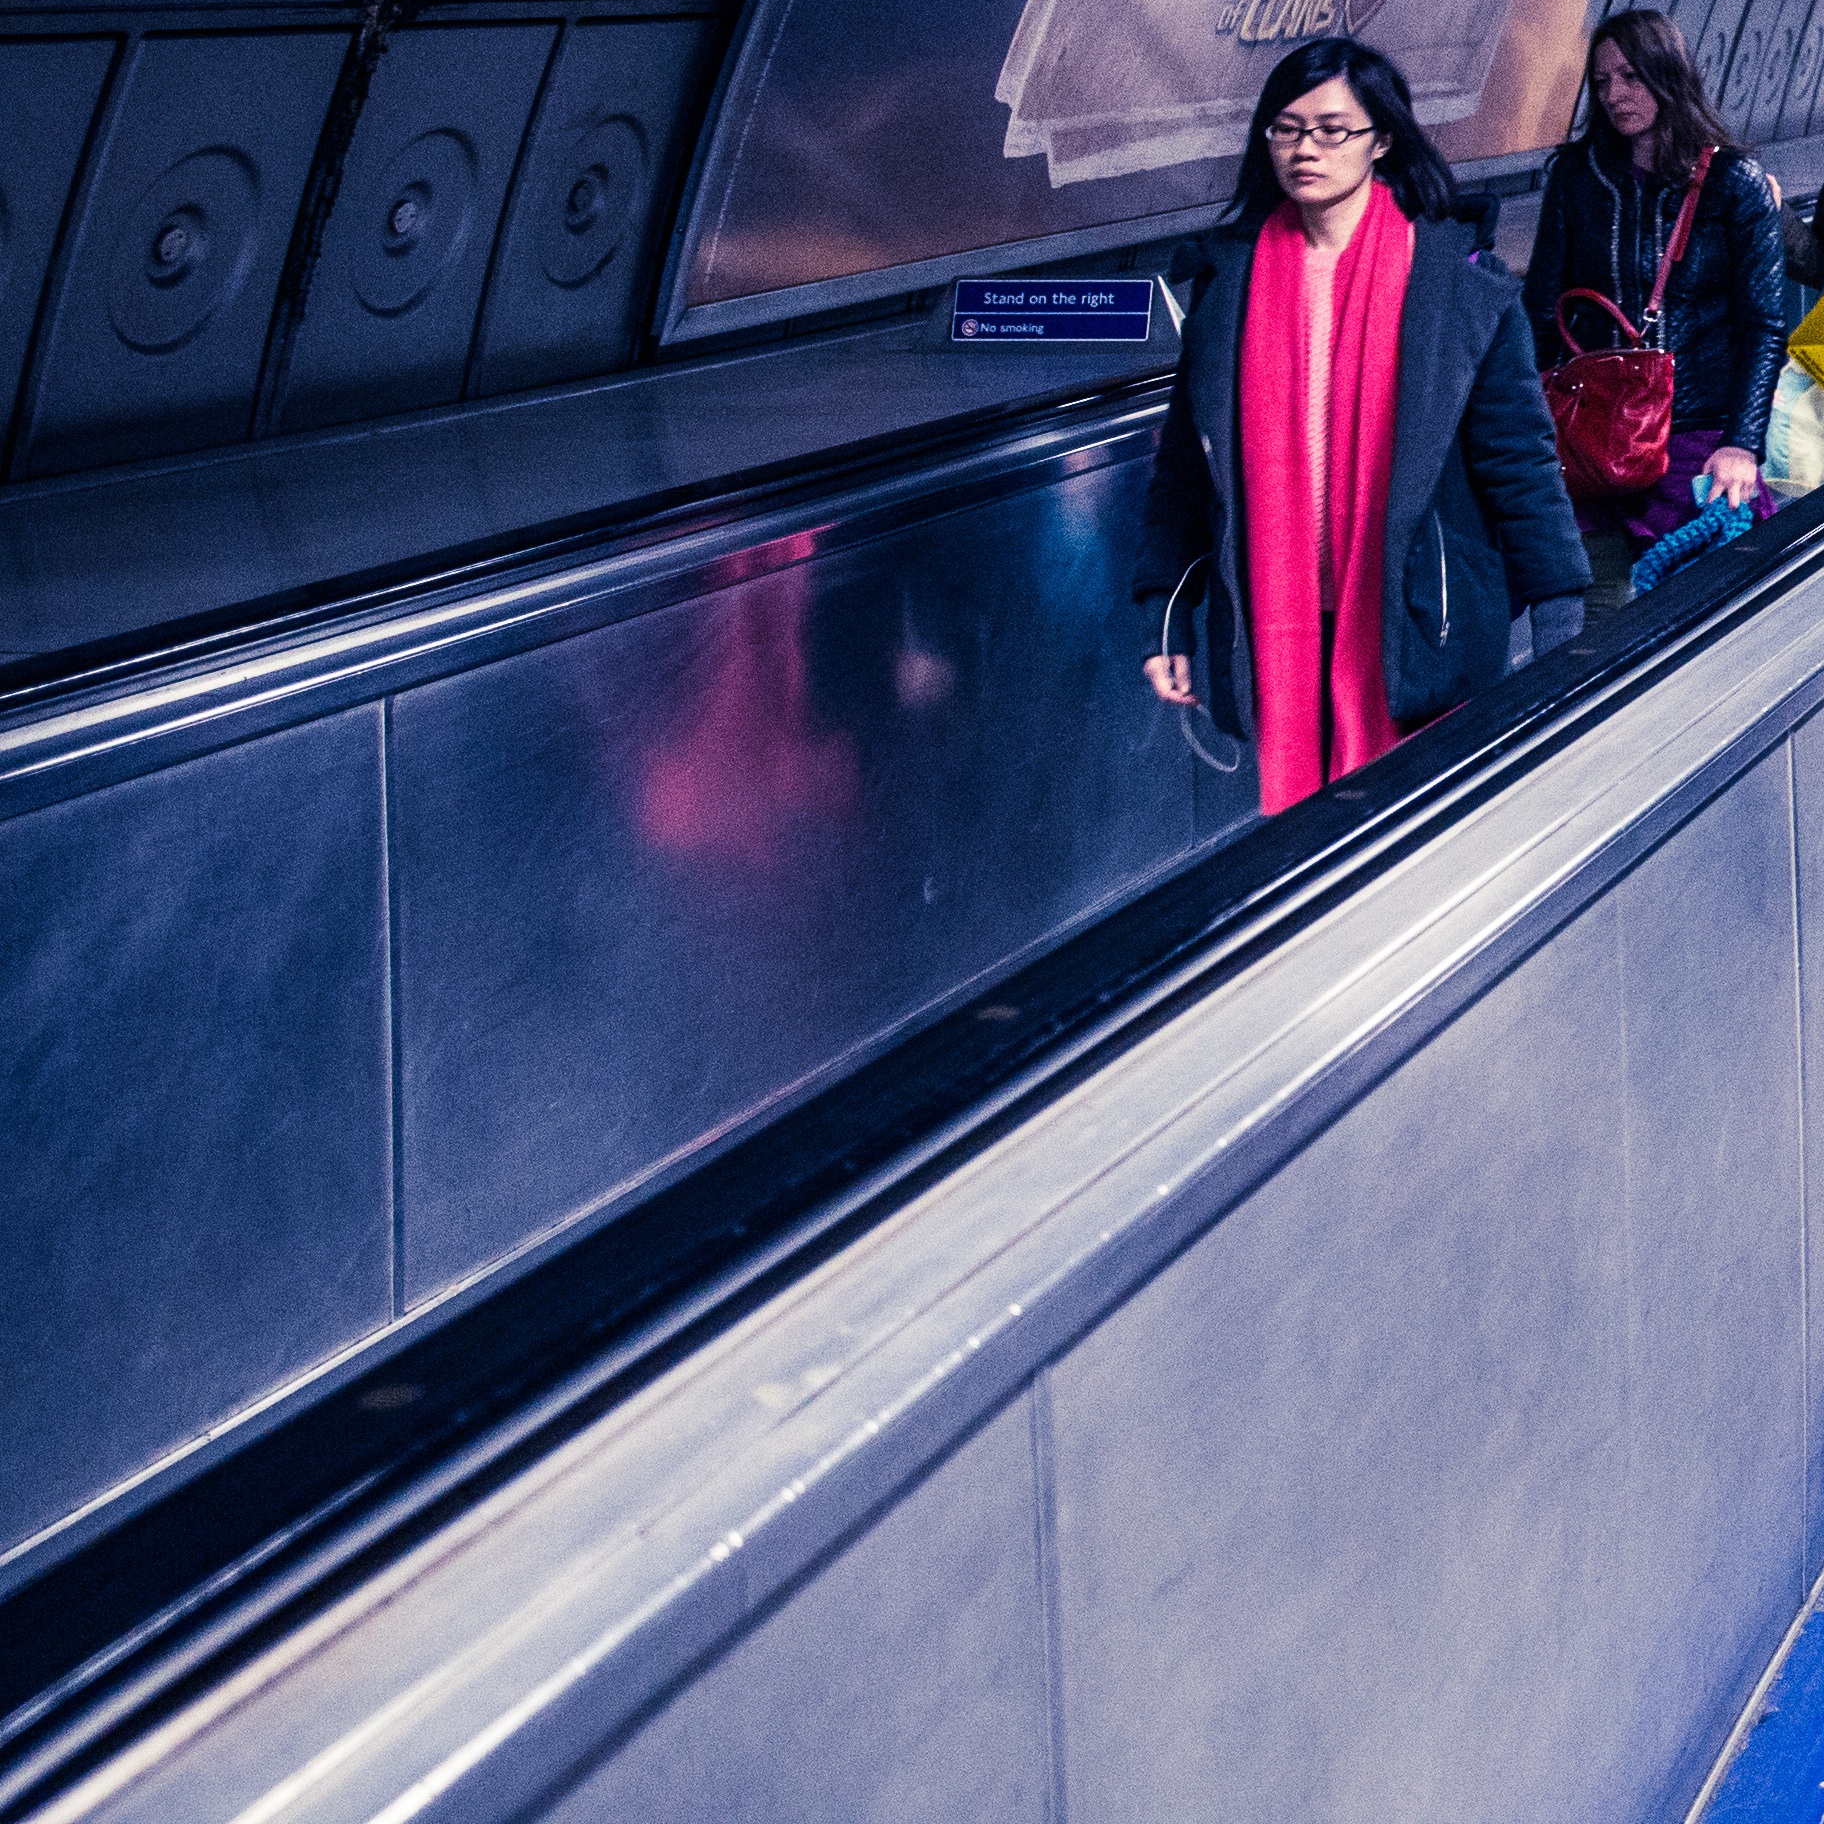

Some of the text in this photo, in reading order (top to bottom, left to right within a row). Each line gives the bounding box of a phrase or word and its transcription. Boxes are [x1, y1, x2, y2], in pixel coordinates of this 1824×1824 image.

[983, 291, 1116, 308] Stand on the right
[979, 322, 1045, 335] No smoking
